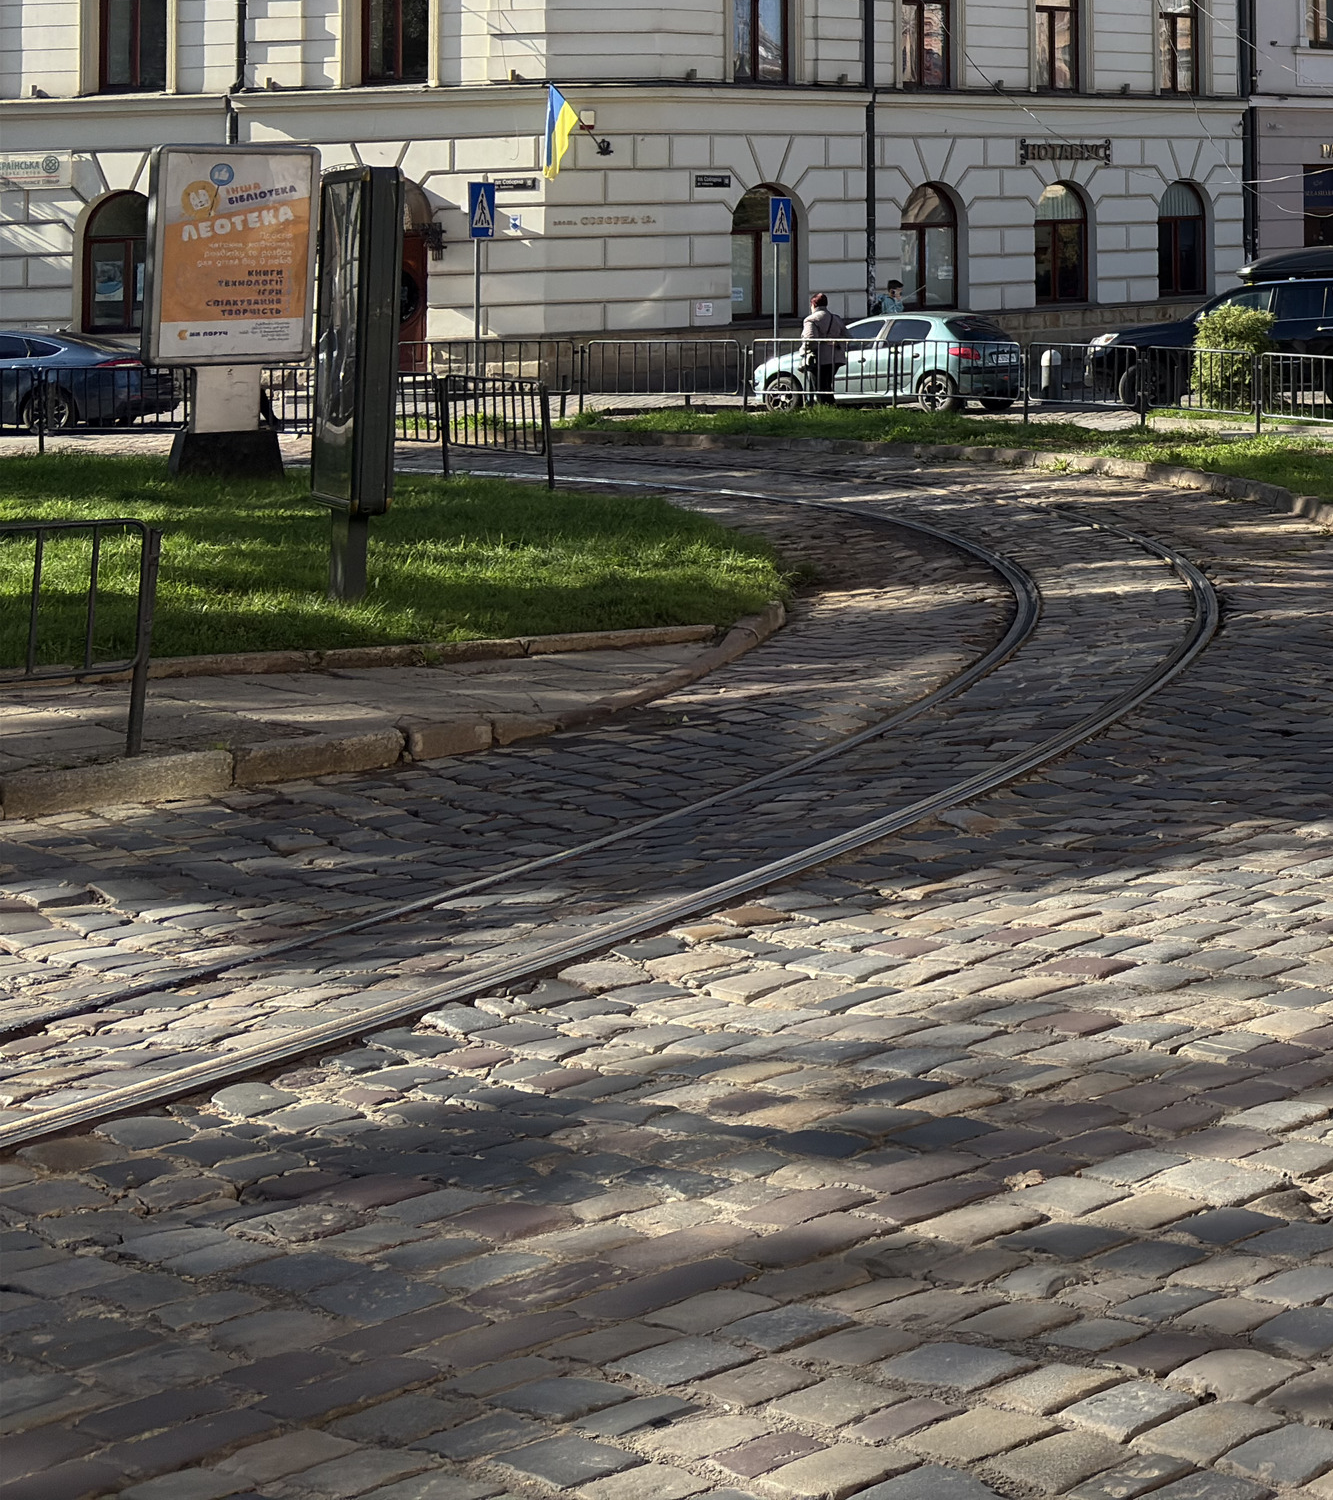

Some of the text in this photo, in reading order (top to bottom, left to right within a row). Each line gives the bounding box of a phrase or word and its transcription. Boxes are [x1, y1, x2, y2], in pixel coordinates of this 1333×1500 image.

[225, 182, 262, 196] ІНША
[227, 184, 298, 206] БІБЛІОТЕКА
[181, 205, 295, 242] ЛЕОТЕКА
[247, 269, 284, 277] КНИГИ
[217, 276, 284, 288] ТЕХНОЛОГІЇ
[257, 288, 283, 296] ІГРИ
[205, 298, 282, 307] СПІЛКУВАННЯ
[221, 308, 282, 317] ТВОРЧІСТЬ
